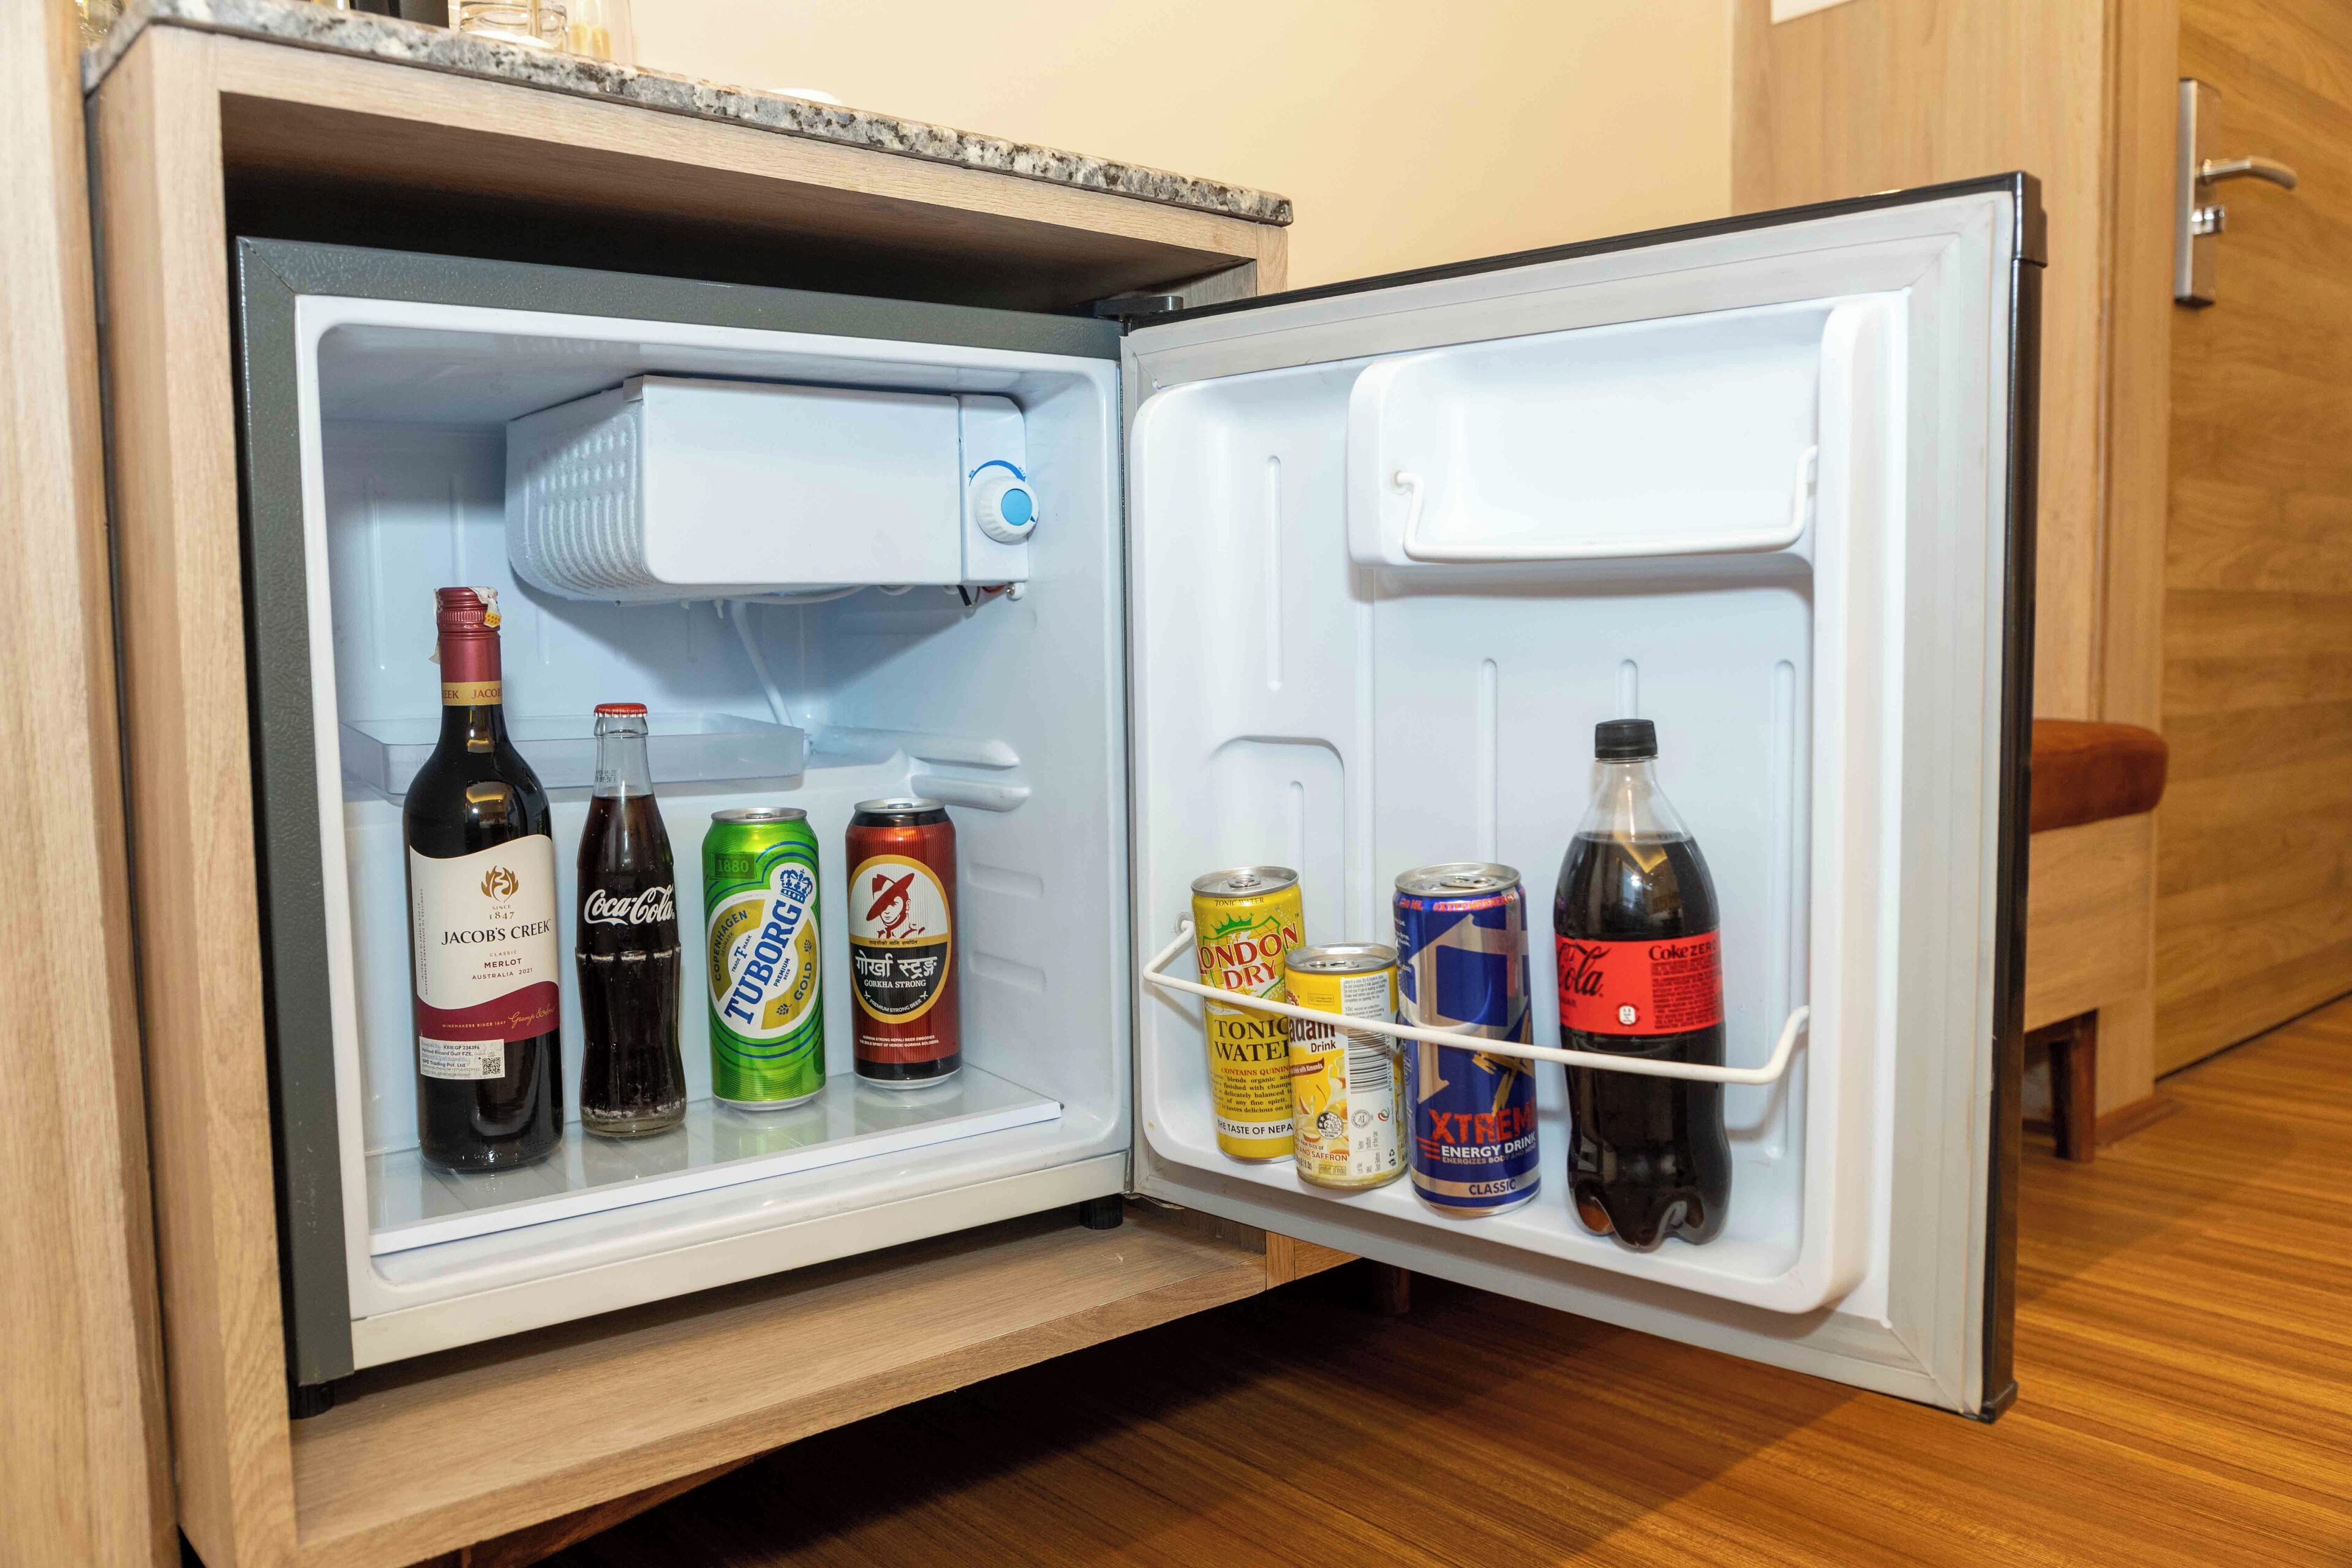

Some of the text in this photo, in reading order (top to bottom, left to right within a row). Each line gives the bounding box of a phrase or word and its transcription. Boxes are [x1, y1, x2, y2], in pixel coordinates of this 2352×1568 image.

[717, 860, 749, 873] 1880
[584, 884, 674, 926] Coca-Cola
[1239, 897, 1265, 907] WATER
[489, 911, 514, 920] 1847
[441, 921, 550, 945] JACOB'S CREEK
[714, 910, 748, 981] COPENHAGEN
[722, 931, 734, 957] DENMARK
[1648, 944, 1688, 960] Coke
[731, 957, 741, 972] TRADE
[744, 935, 752, 950] MARK
[484, 958, 522, 968] MERLOT
[724, 899, 802, 1025] TUBORG
[855, 949, 894, 978] गोर्खा
[472, 971, 514, 980] AUSTRALIA
[774, 958, 790, 987] PREMIUM
[1223, 959, 1276, 990] DRY
[794, 962, 812, 1001] GOLD
[864, 979, 926, 988] GORKHA STRONG
[869, 998, 889, 1012] PREMIUM
[910, 999, 922, 1009] BEER
[1214, 1017, 1289, 1040] TONIC
[1311, 1039, 1336, 1053] Drink
[1221, 1068, 1257, 1076] CONTAINS
[1259, 1065, 1290, 1076] QUININ
[1224, 1082, 1246, 1091] finished
[1224, 1090, 1251, 1099] delicately
[1254, 1090, 1284, 1098] balanced
[1217, 1119, 1294, 1135] THE TASTE OF NEPA
[1442, 1132, 1537, 1158] ENERGY DRINK
[1299, 1147, 1310, 1156] AND
[1311, 1151, 1348, 1161] SAFFRON
[1442, 1156, 1487, 1165] ENERGIZES
[1488, 1155, 1509, 1164] BODY
[1469, 1179, 1517, 1196] CLASSIC
